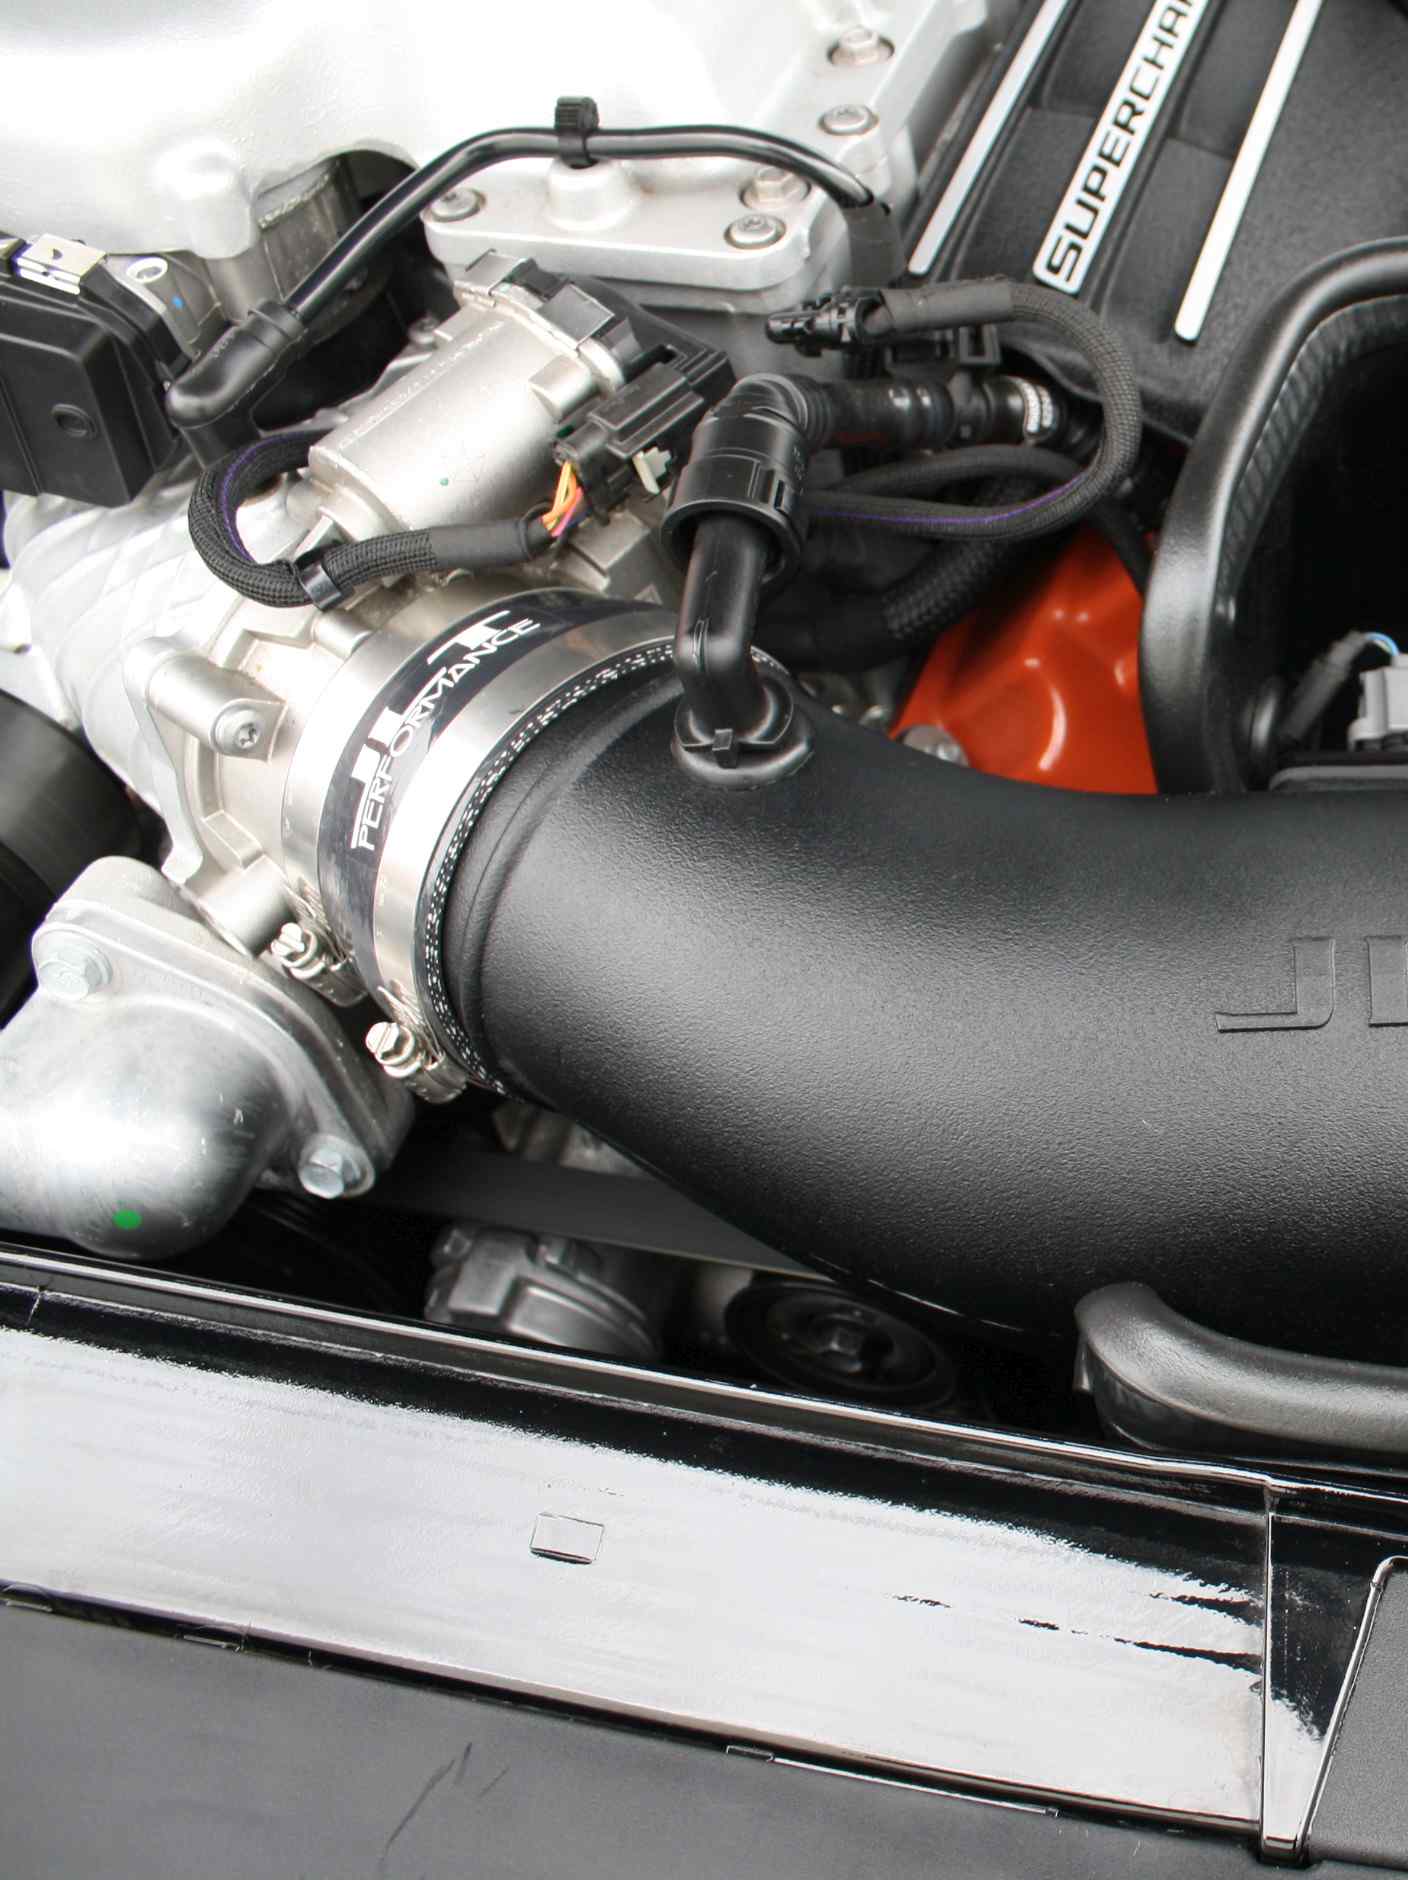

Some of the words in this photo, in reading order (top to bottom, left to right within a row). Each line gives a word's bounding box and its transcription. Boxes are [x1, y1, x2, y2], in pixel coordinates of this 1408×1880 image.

[1046, 0, 1192, 283] SUPERCHA
[351, 610, 511, 849] JLT
[357, 618, 541, 852] PERFORMANCE
